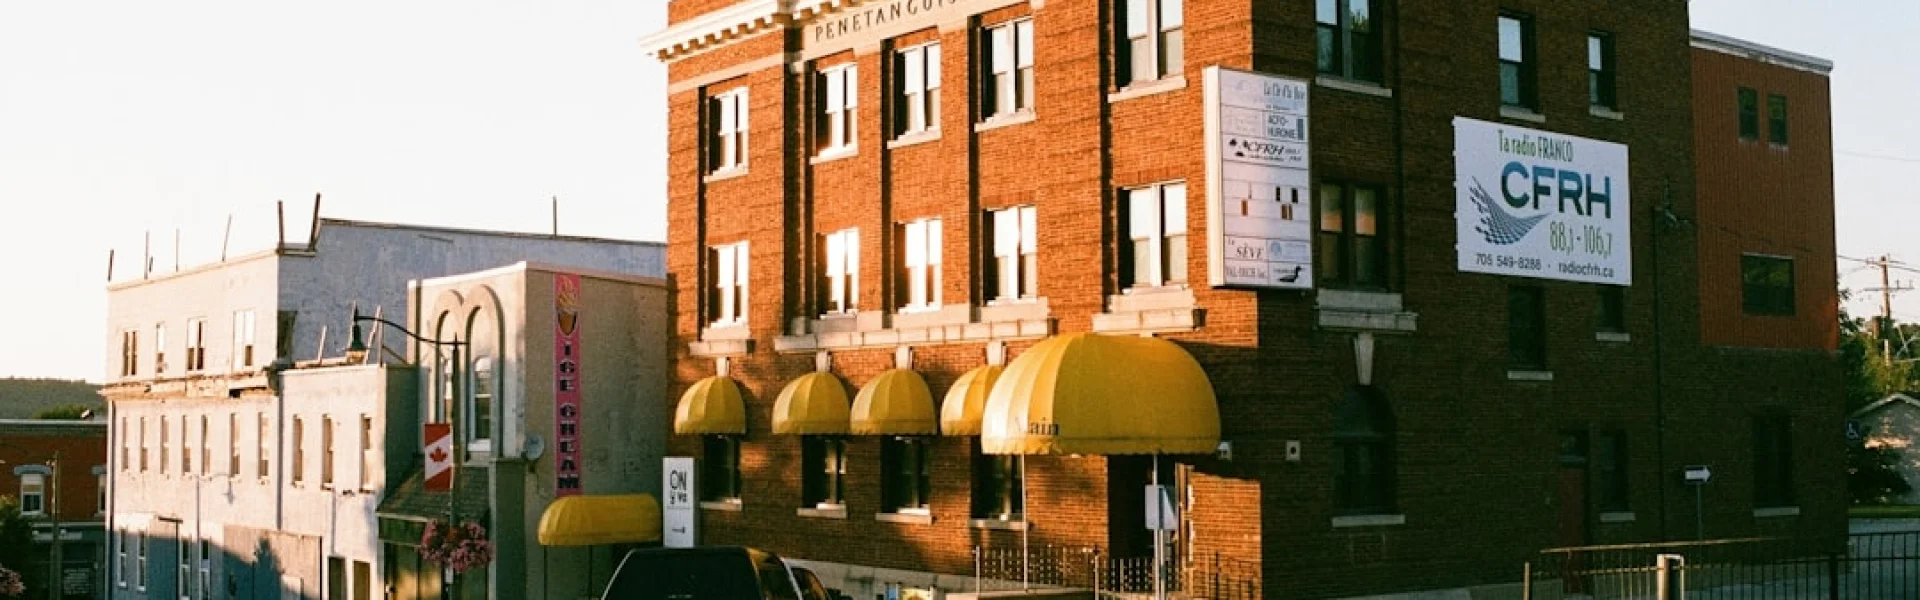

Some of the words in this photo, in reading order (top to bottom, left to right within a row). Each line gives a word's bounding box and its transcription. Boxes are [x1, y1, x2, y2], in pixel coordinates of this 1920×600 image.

[815, 0, 957, 42] PENETANGU
[1498, 129, 1509, 152] Ta
[1511, 133, 1536, 157] radio
[1538, 136, 1574, 162] FRANCO
[1501, 161, 1612, 219] CFRH
[1476, 253, 1493, 267] 705
[1496, 254, 1542, 271] 549-8288
[1558, 261, 1615, 278] radiocfrh.ca
[558, 340, 577, 392] ICE
[557, 402, 580, 489] CREAM
[669, 469, 687, 491] ON
